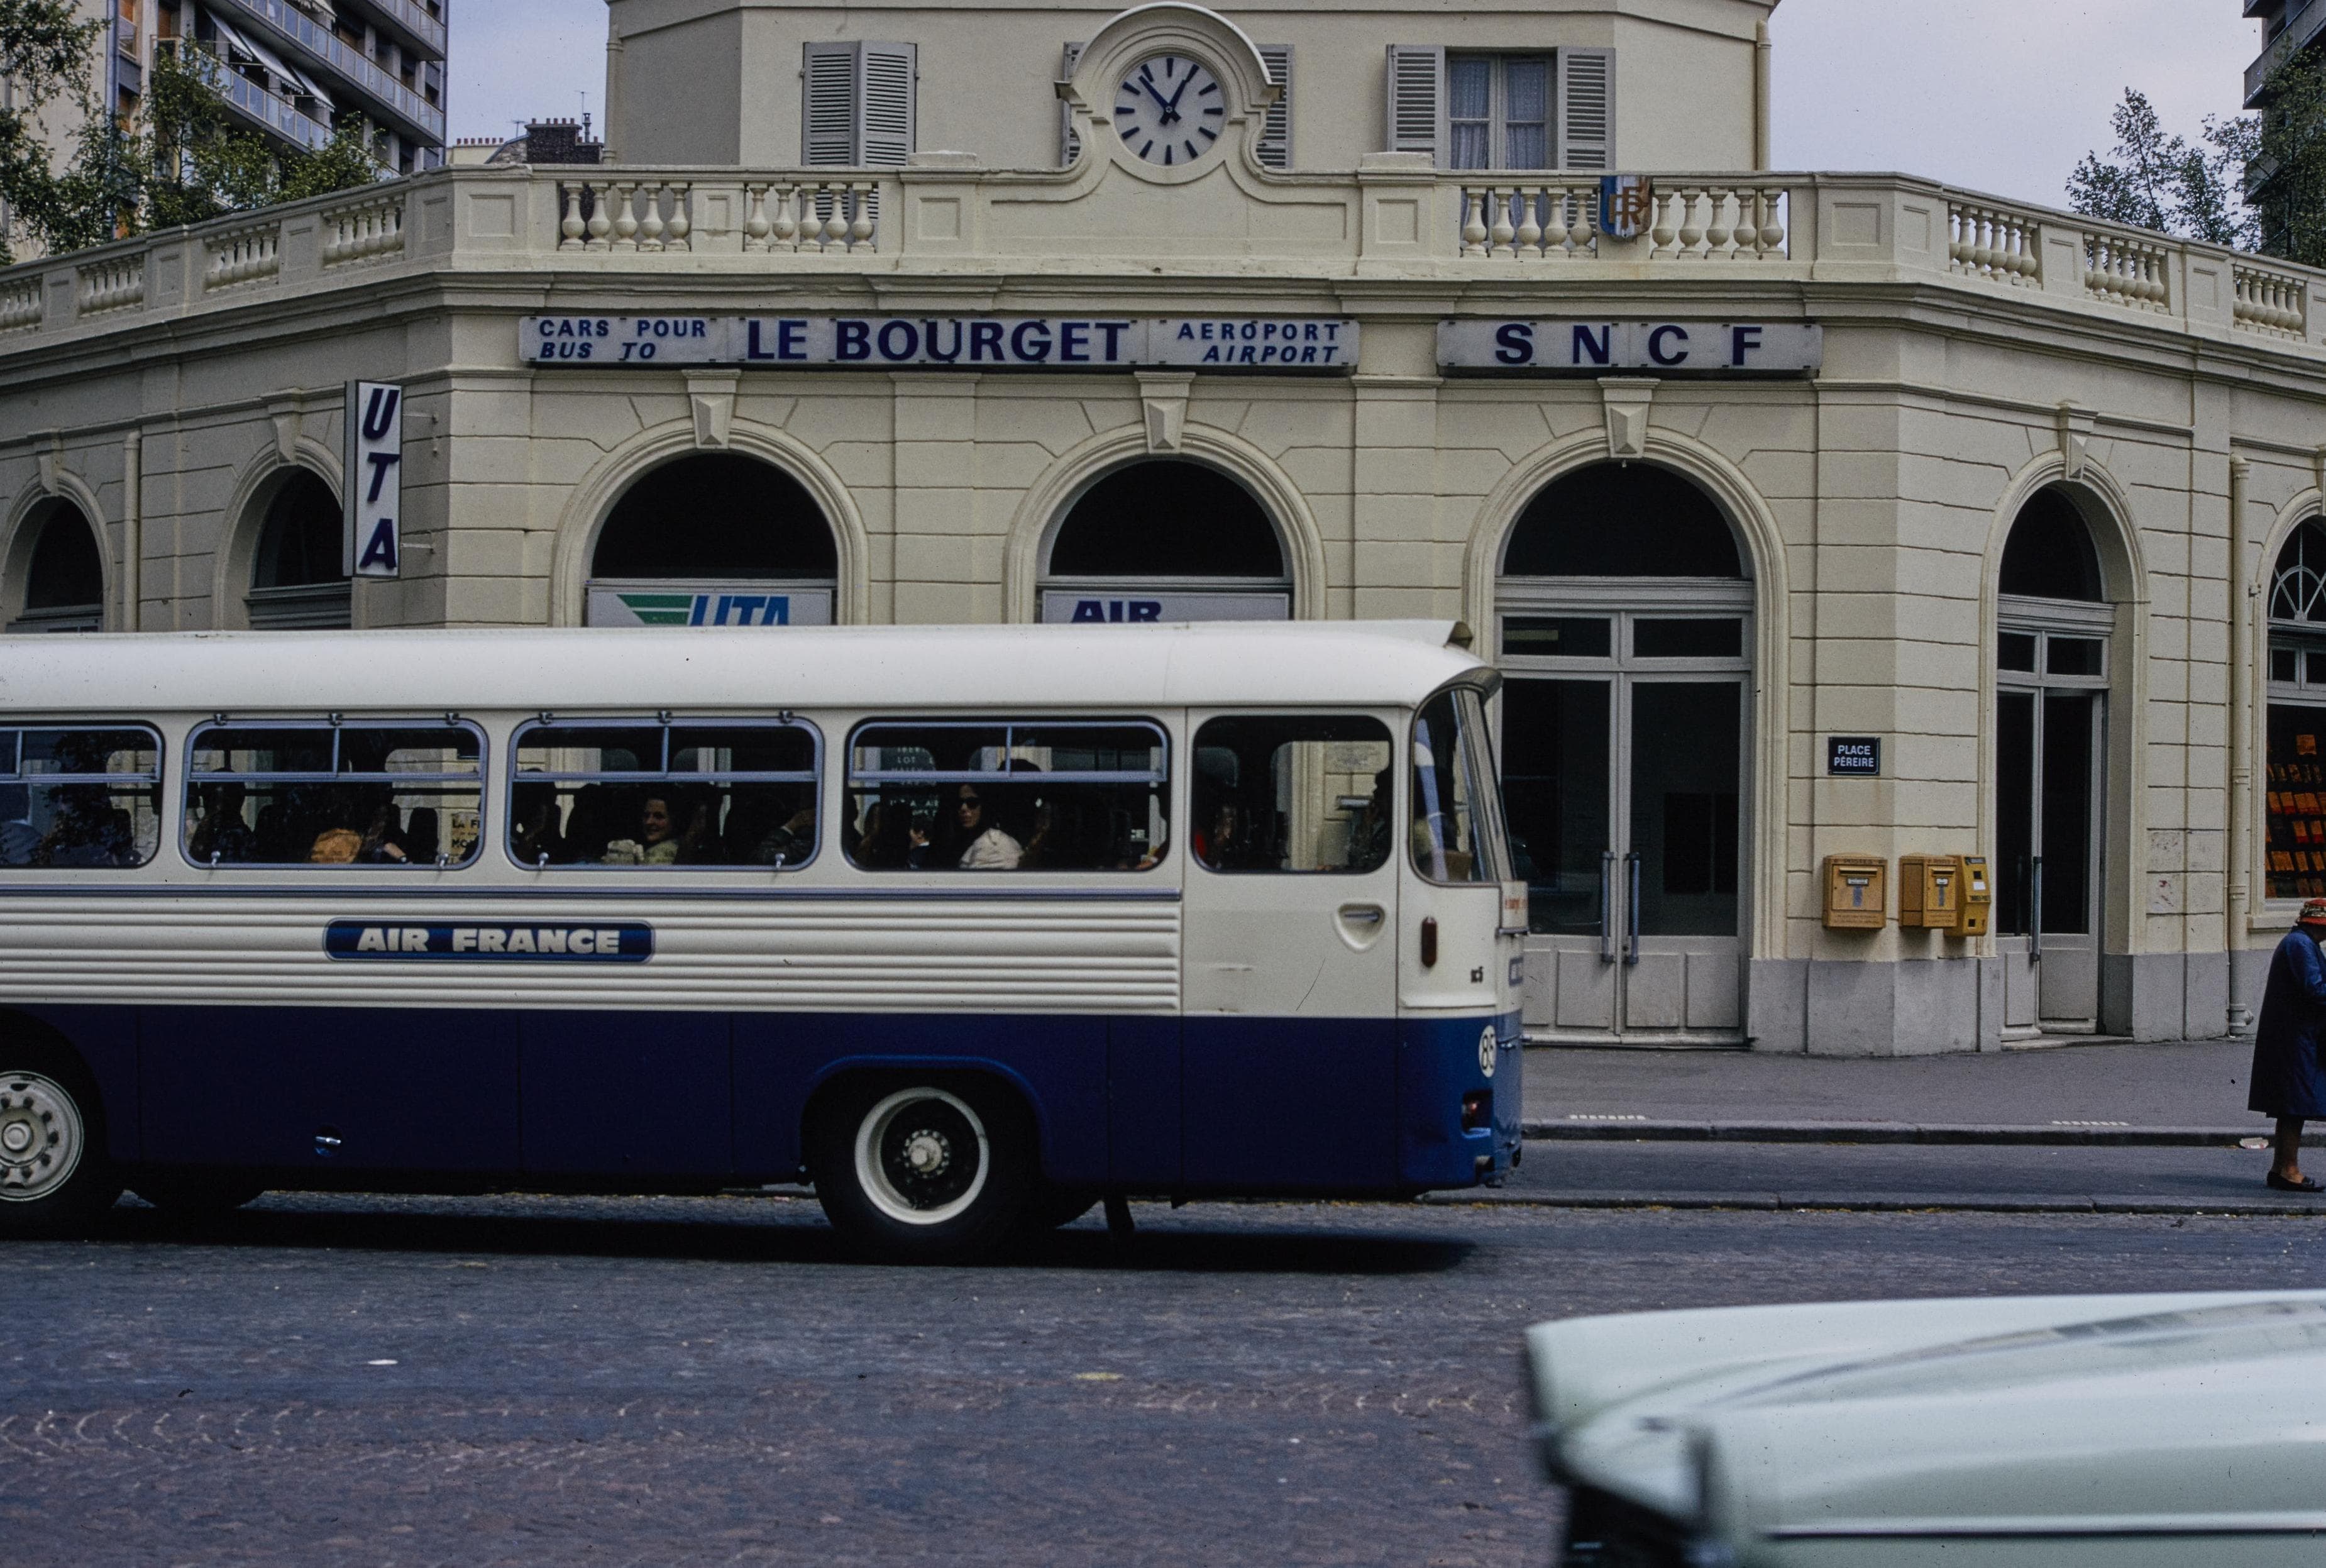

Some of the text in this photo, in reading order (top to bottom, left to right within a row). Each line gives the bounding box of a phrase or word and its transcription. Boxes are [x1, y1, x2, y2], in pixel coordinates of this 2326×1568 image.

[540, 319, 706, 337] CARS POUR
[1177, 323, 1340, 341] AEROPORT
[747, 320, 1130, 362] LE BOURGET
[539, 342, 656, 359] BUS TO
[1203, 345, 1339, 363] AIRPORT
[359, 388, 400, 568] UTA
[1071, 600, 1162, 622] AIR
[1838, 744, 1871, 755] PLACE
[356, 927, 620, 954] AIR FRANCE
